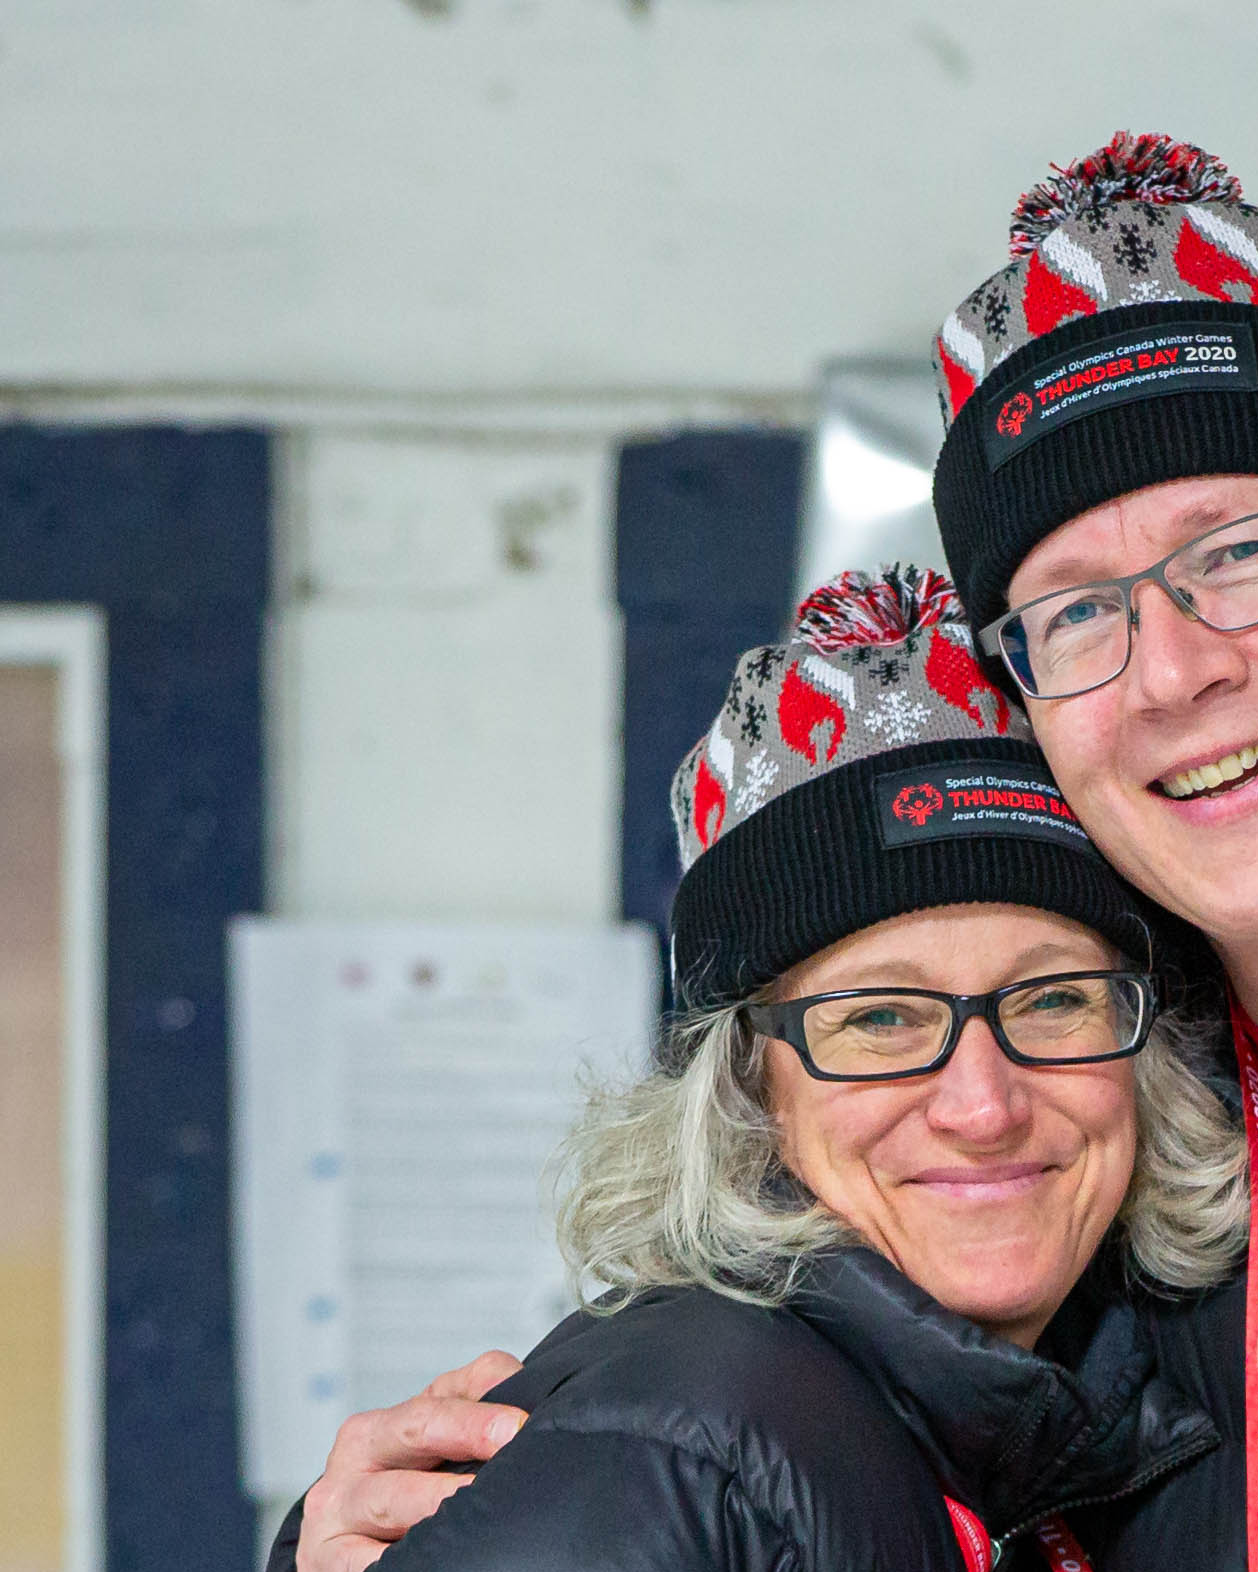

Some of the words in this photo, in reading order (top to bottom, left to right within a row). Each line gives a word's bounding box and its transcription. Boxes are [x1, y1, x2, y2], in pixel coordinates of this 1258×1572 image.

[1034, 365, 1067, 389] Special
[1069, 350, 1115, 371] Olympics
[1116, 340, 1155, 355] Canada
[1155, 334, 1193, 347] Winter
[1195, 333, 1233, 344] Games
[1036, 358, 1135, 405] THUNDER
[1137, 347, 1179, 369] BAY
[1184, 346, 1237, 361] 2020
[1040, 403, 1060, 419] Jeux
[1061, 390, 1092, 408] d'Hiver
[1093, 371, 1157, 394] d'Olympiques
[1158, 364, 1200, 379] spéciaux
[1201, 364, 1239, 373] Canada
[945, 775, 984, 789] Special
[986, 776, 1029, 789] Olympics
[948, 789, 1047, 812] THUNDER
[1050, 798, 1077, 822] BA
[952, 812, 976, 821] Jeux
